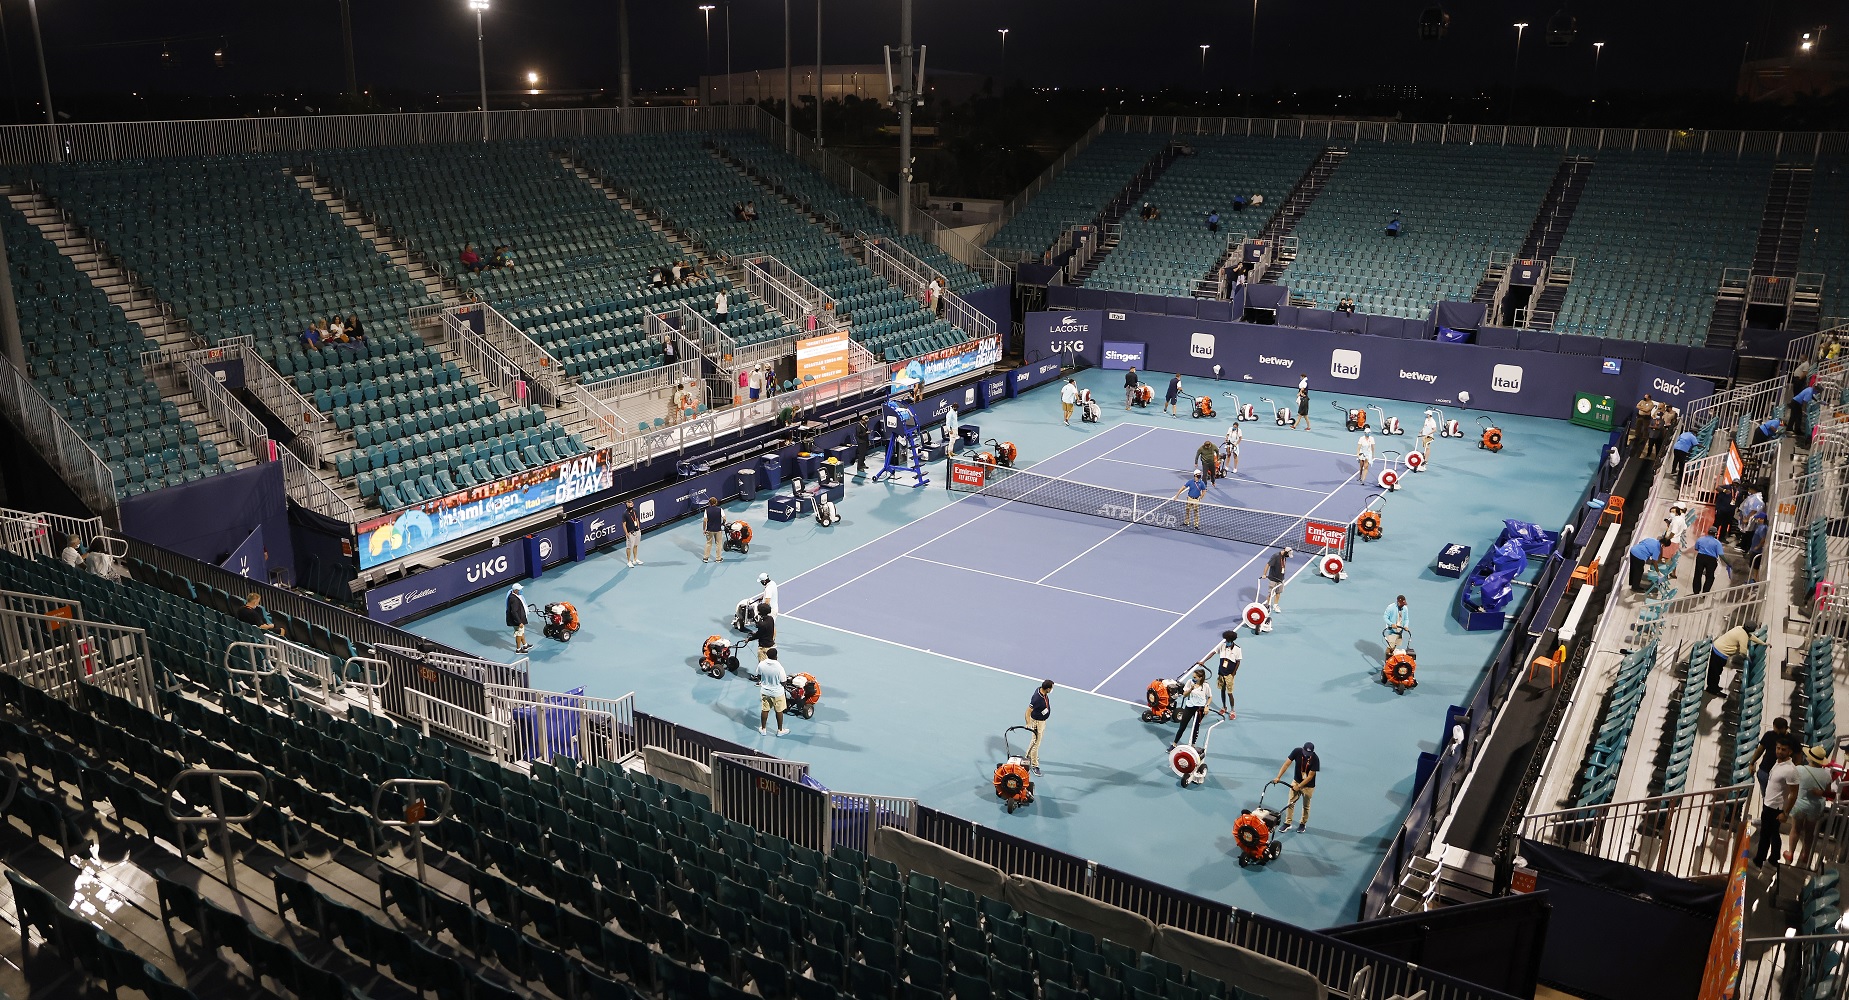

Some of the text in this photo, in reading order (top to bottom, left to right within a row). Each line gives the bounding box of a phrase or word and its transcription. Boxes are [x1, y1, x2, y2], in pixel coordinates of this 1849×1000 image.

[1049, 324, 1089, 333] LACOSTE
[1192, 344, 1212, 355] Itaú
[1259, 354, 1293, 369] betway
[1332, 362, 1358, 375] Itaú
[1399, 369, 1438, 384] betway
[1493, 376, 1519, 389] Itaú
[1653, 377, 1680, 396] Claro
[1595, 403, 1611, 411] ROLEX
[559, 454, 598, 484] RAIN
[954, 466, 983, 478] Emirates
[554, 470, 603, 505] DELAY
[485, 492, 519, 515] open
[640, 508, 654, 520] Itaú
[1096, 503, 1178, 528] ATP TOUR
[583, 524, 616, 544] ACOSTE
[1438, 561, 1460, 572] FedEx
[404, 587, 437, 604] Cadillac
[760, 777, 776, 793] EXIT
